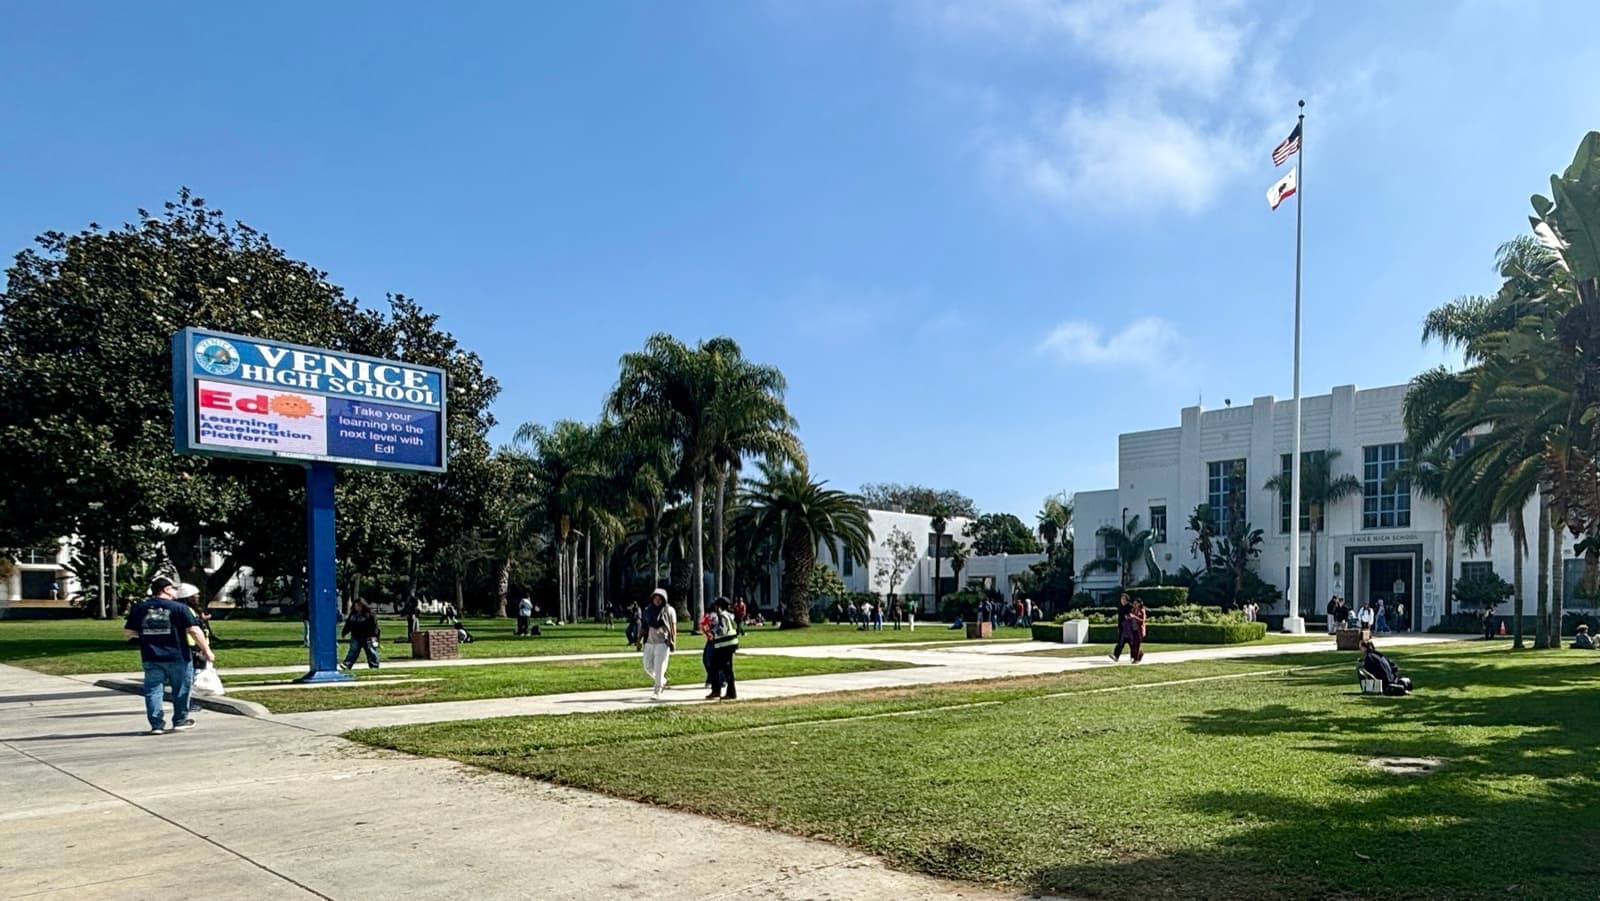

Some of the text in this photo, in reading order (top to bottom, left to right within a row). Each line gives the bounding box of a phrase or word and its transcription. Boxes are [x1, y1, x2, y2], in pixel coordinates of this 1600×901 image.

[256, 344, 428, 390] VENICE
[241, 364, 320, 389] HIGH
[329, 377, 440, 406] SCHOOL
[200, 389, 269, 415] Ed
[200, 414, 279, 430] Learning
[352, 405, 412, 422] Take your
[200, 422, 312, 440] Acceleration
[339, 416, 424, 434] learning to the
[200, 430, 279, 444] Platform
[340, 429, 424, 446] next level with
[374, 443, 395, 455] Ed!
